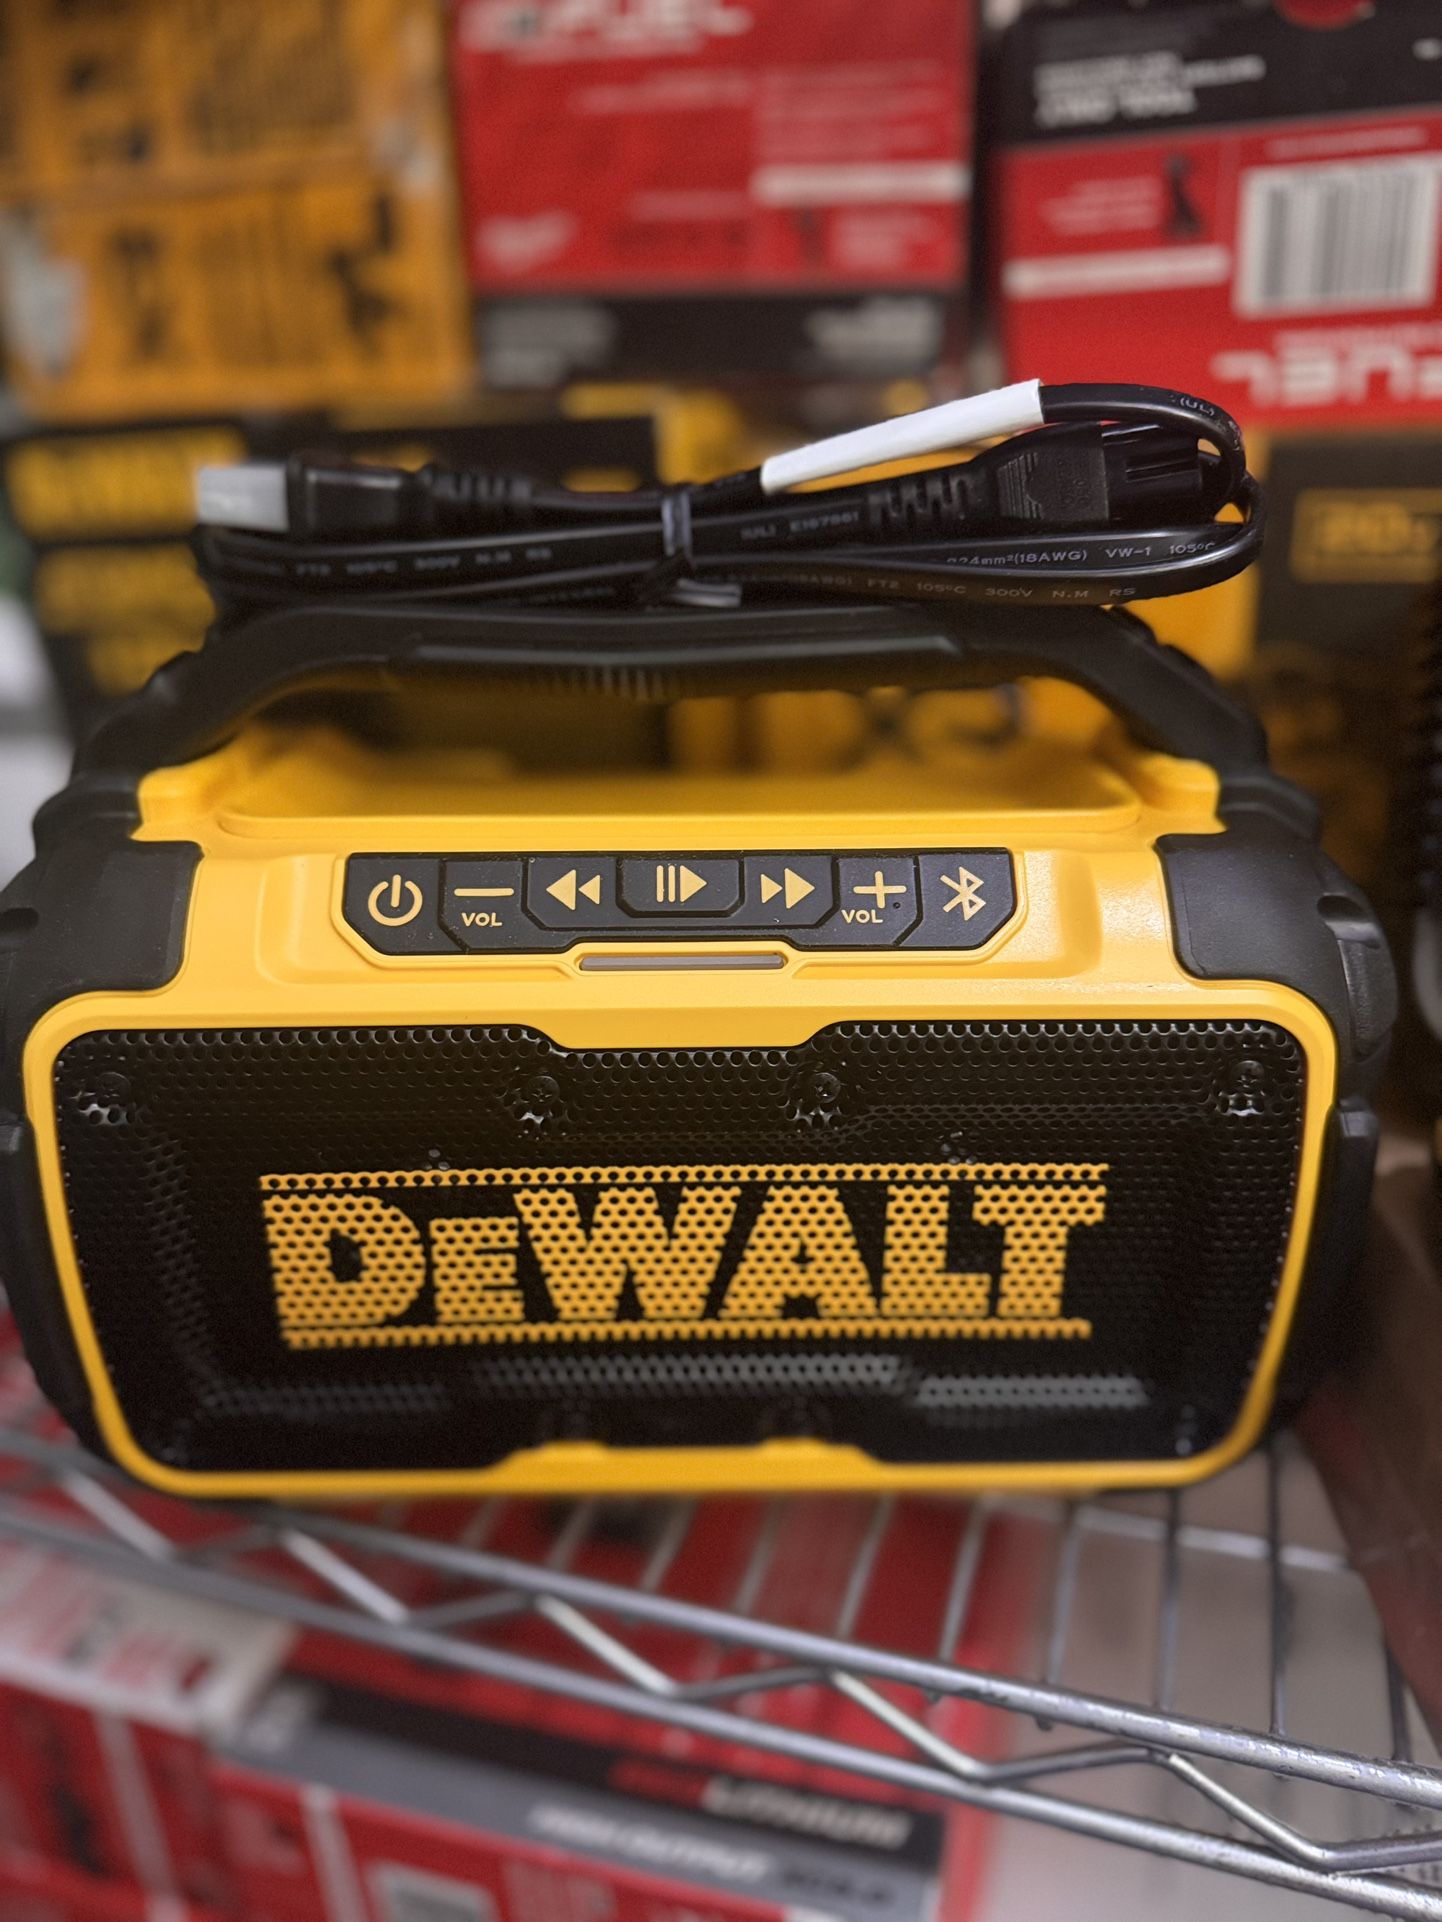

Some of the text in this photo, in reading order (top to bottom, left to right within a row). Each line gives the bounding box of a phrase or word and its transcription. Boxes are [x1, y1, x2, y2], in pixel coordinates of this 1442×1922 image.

[1105, 546, 1151, 559] VW-1
[984, 586, 1033, 598] 300V
[461, 911, 503, 928] VOL
[840, 907, 884, 925] VOL
